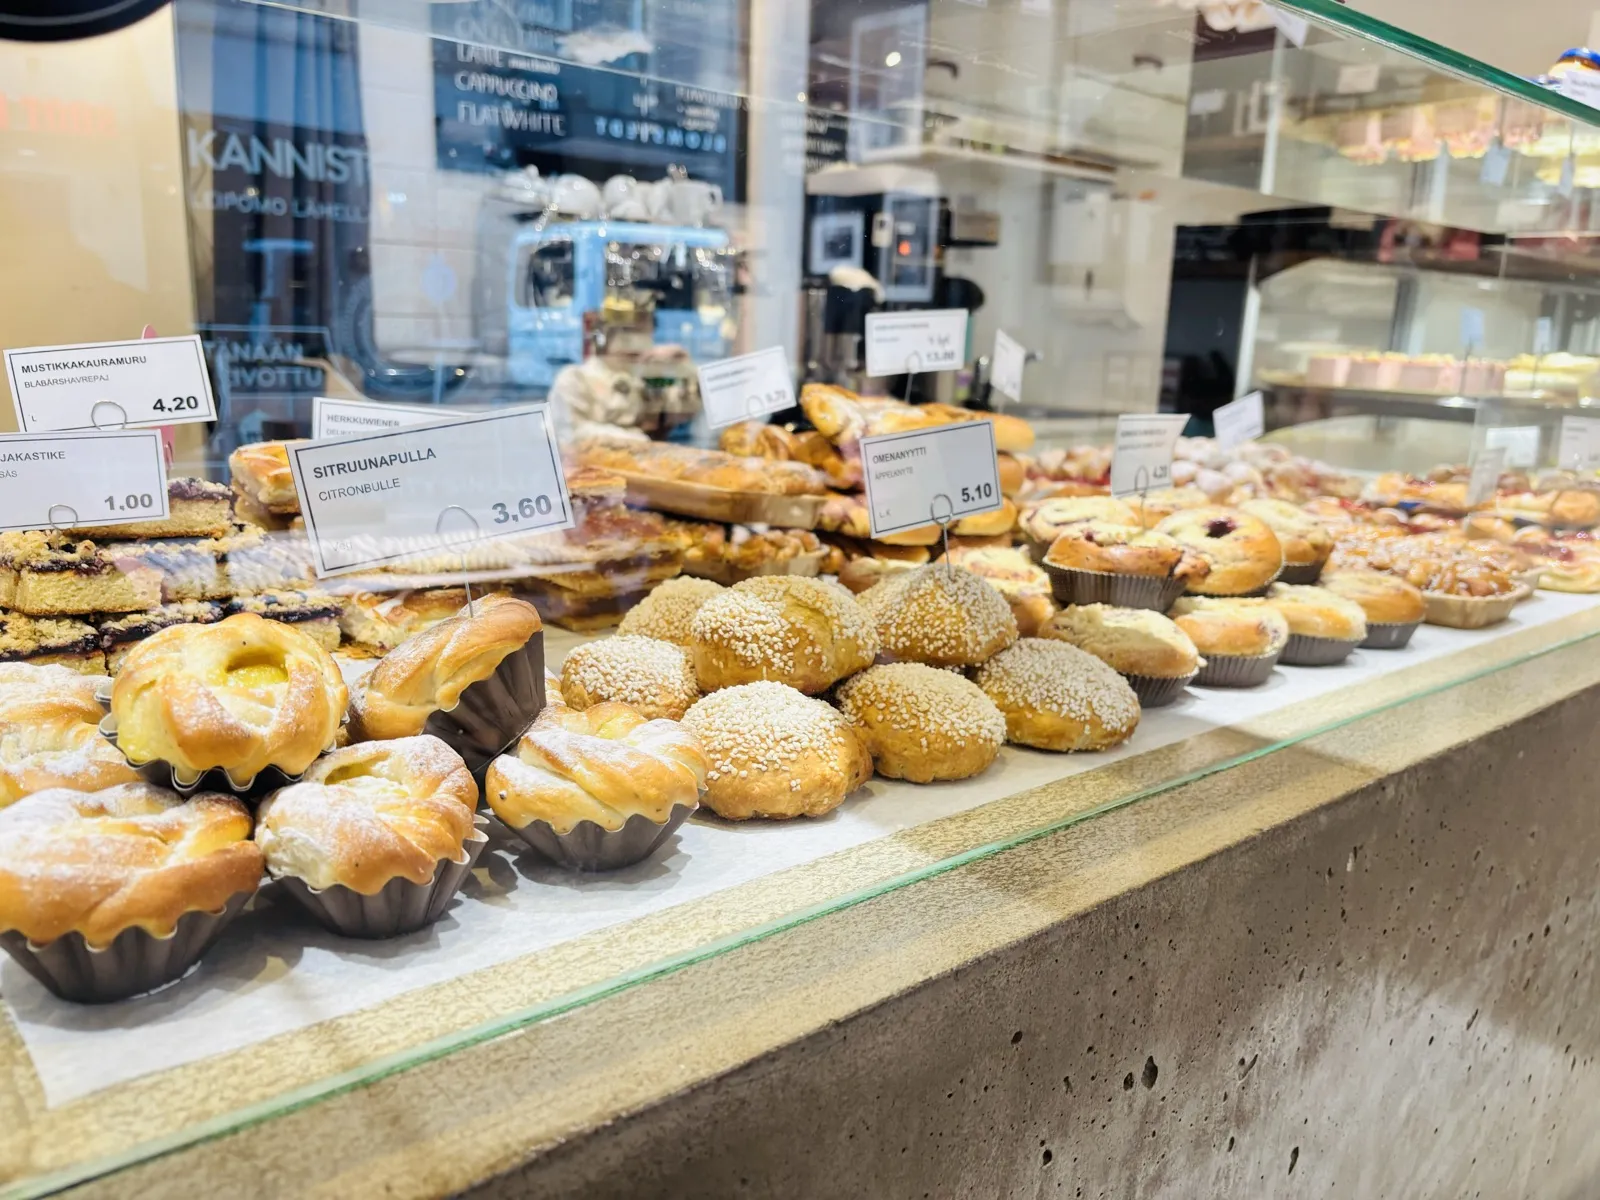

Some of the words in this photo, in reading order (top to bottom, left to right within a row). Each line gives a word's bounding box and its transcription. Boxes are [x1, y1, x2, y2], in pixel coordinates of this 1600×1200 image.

[21, 356, 147, 373] MUSTIKKAKAURAMURU
[152, 395, 199, 413] 4,20
[313, 448, 436, 479] SITRUUNAPULLA
[872, 447, 926, 464] OMENANYYTTI
[318, 478, 400, 501] CITRONBULLE
[104, 494, 153, 511] 1,00
[491, 494, 552, 524] 3,60
